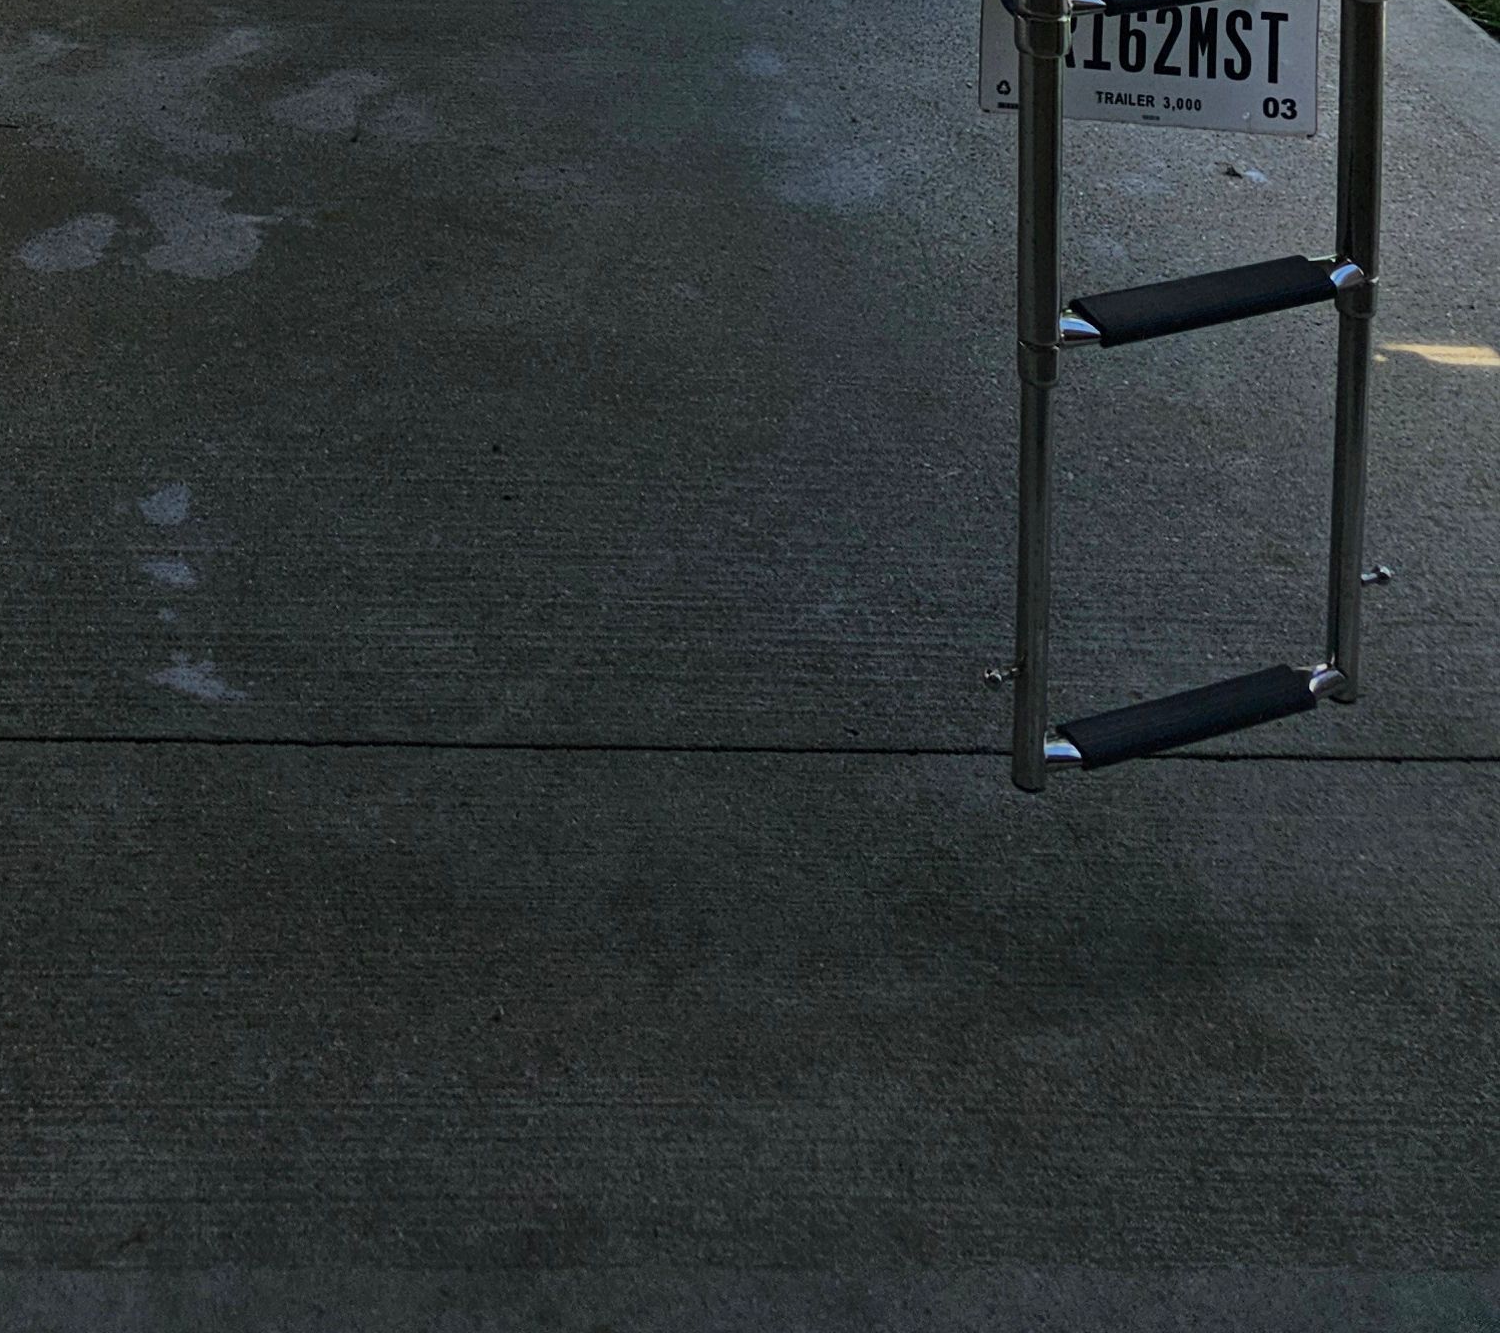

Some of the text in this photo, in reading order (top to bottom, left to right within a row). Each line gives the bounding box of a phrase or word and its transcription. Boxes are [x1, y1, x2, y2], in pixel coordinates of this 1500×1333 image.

[1096, 91, 1202, 112] TRAILER 3,000
[1262, 97, 1298, 121] 03
